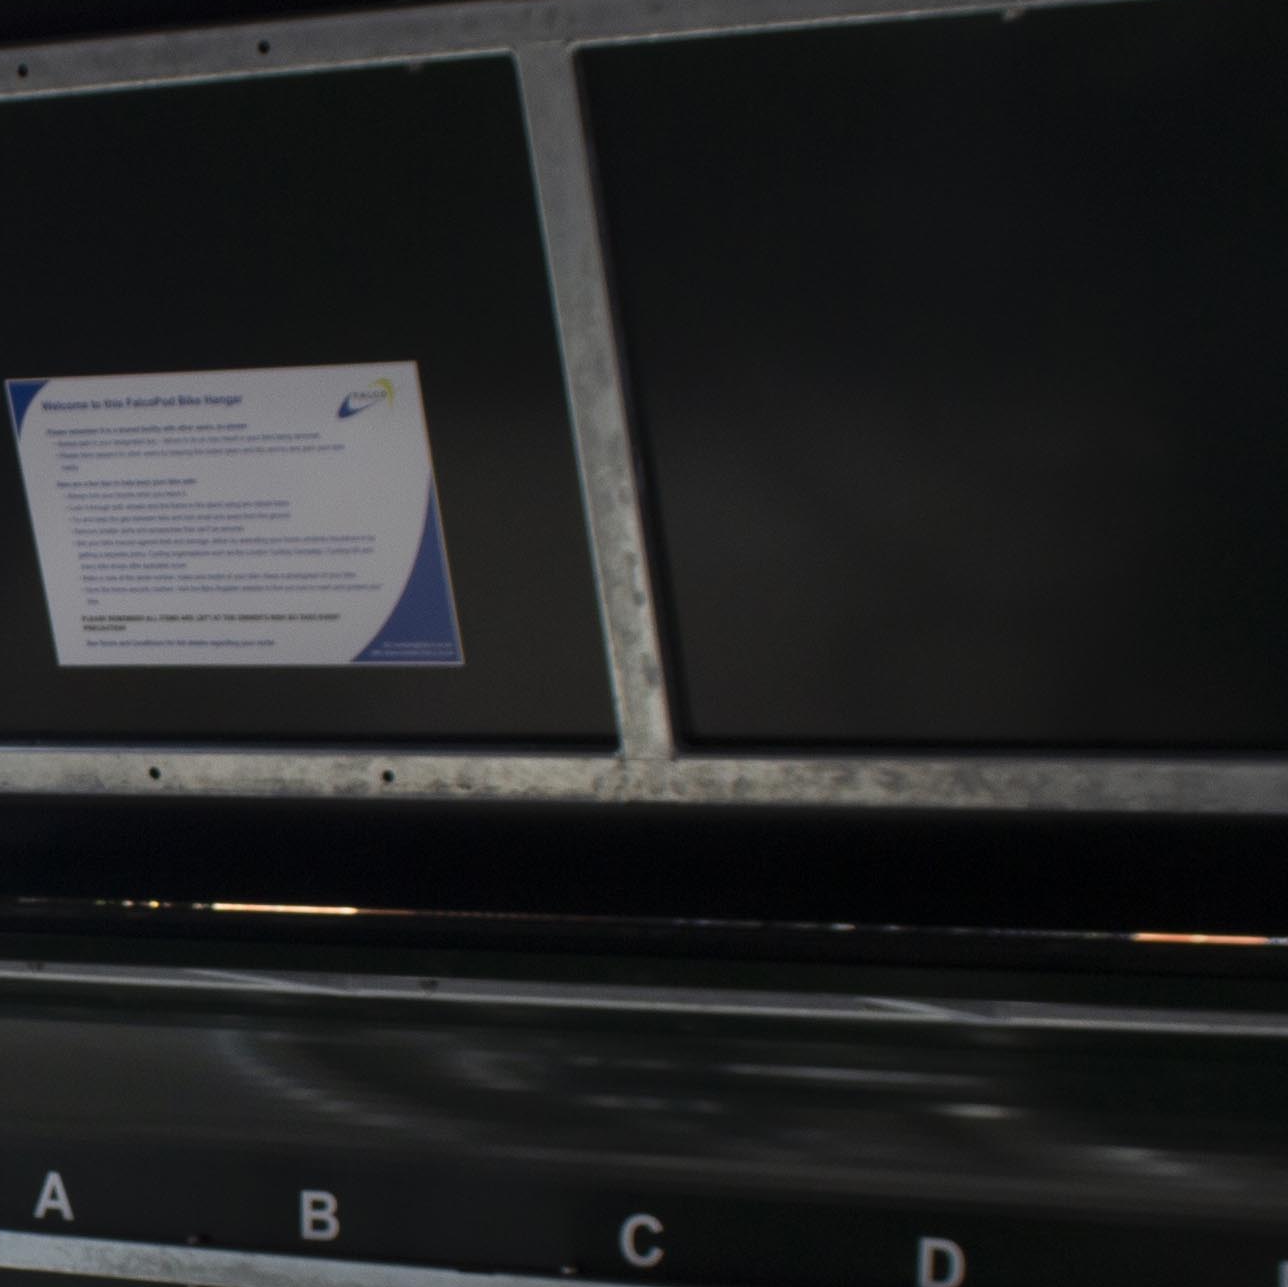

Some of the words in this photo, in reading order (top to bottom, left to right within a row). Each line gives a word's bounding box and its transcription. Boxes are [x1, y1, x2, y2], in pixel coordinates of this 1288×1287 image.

[34, 1171, 73, 1220] A
[300, 1189, 340, 1240] B
[619, 1213, 664, 1267] C
